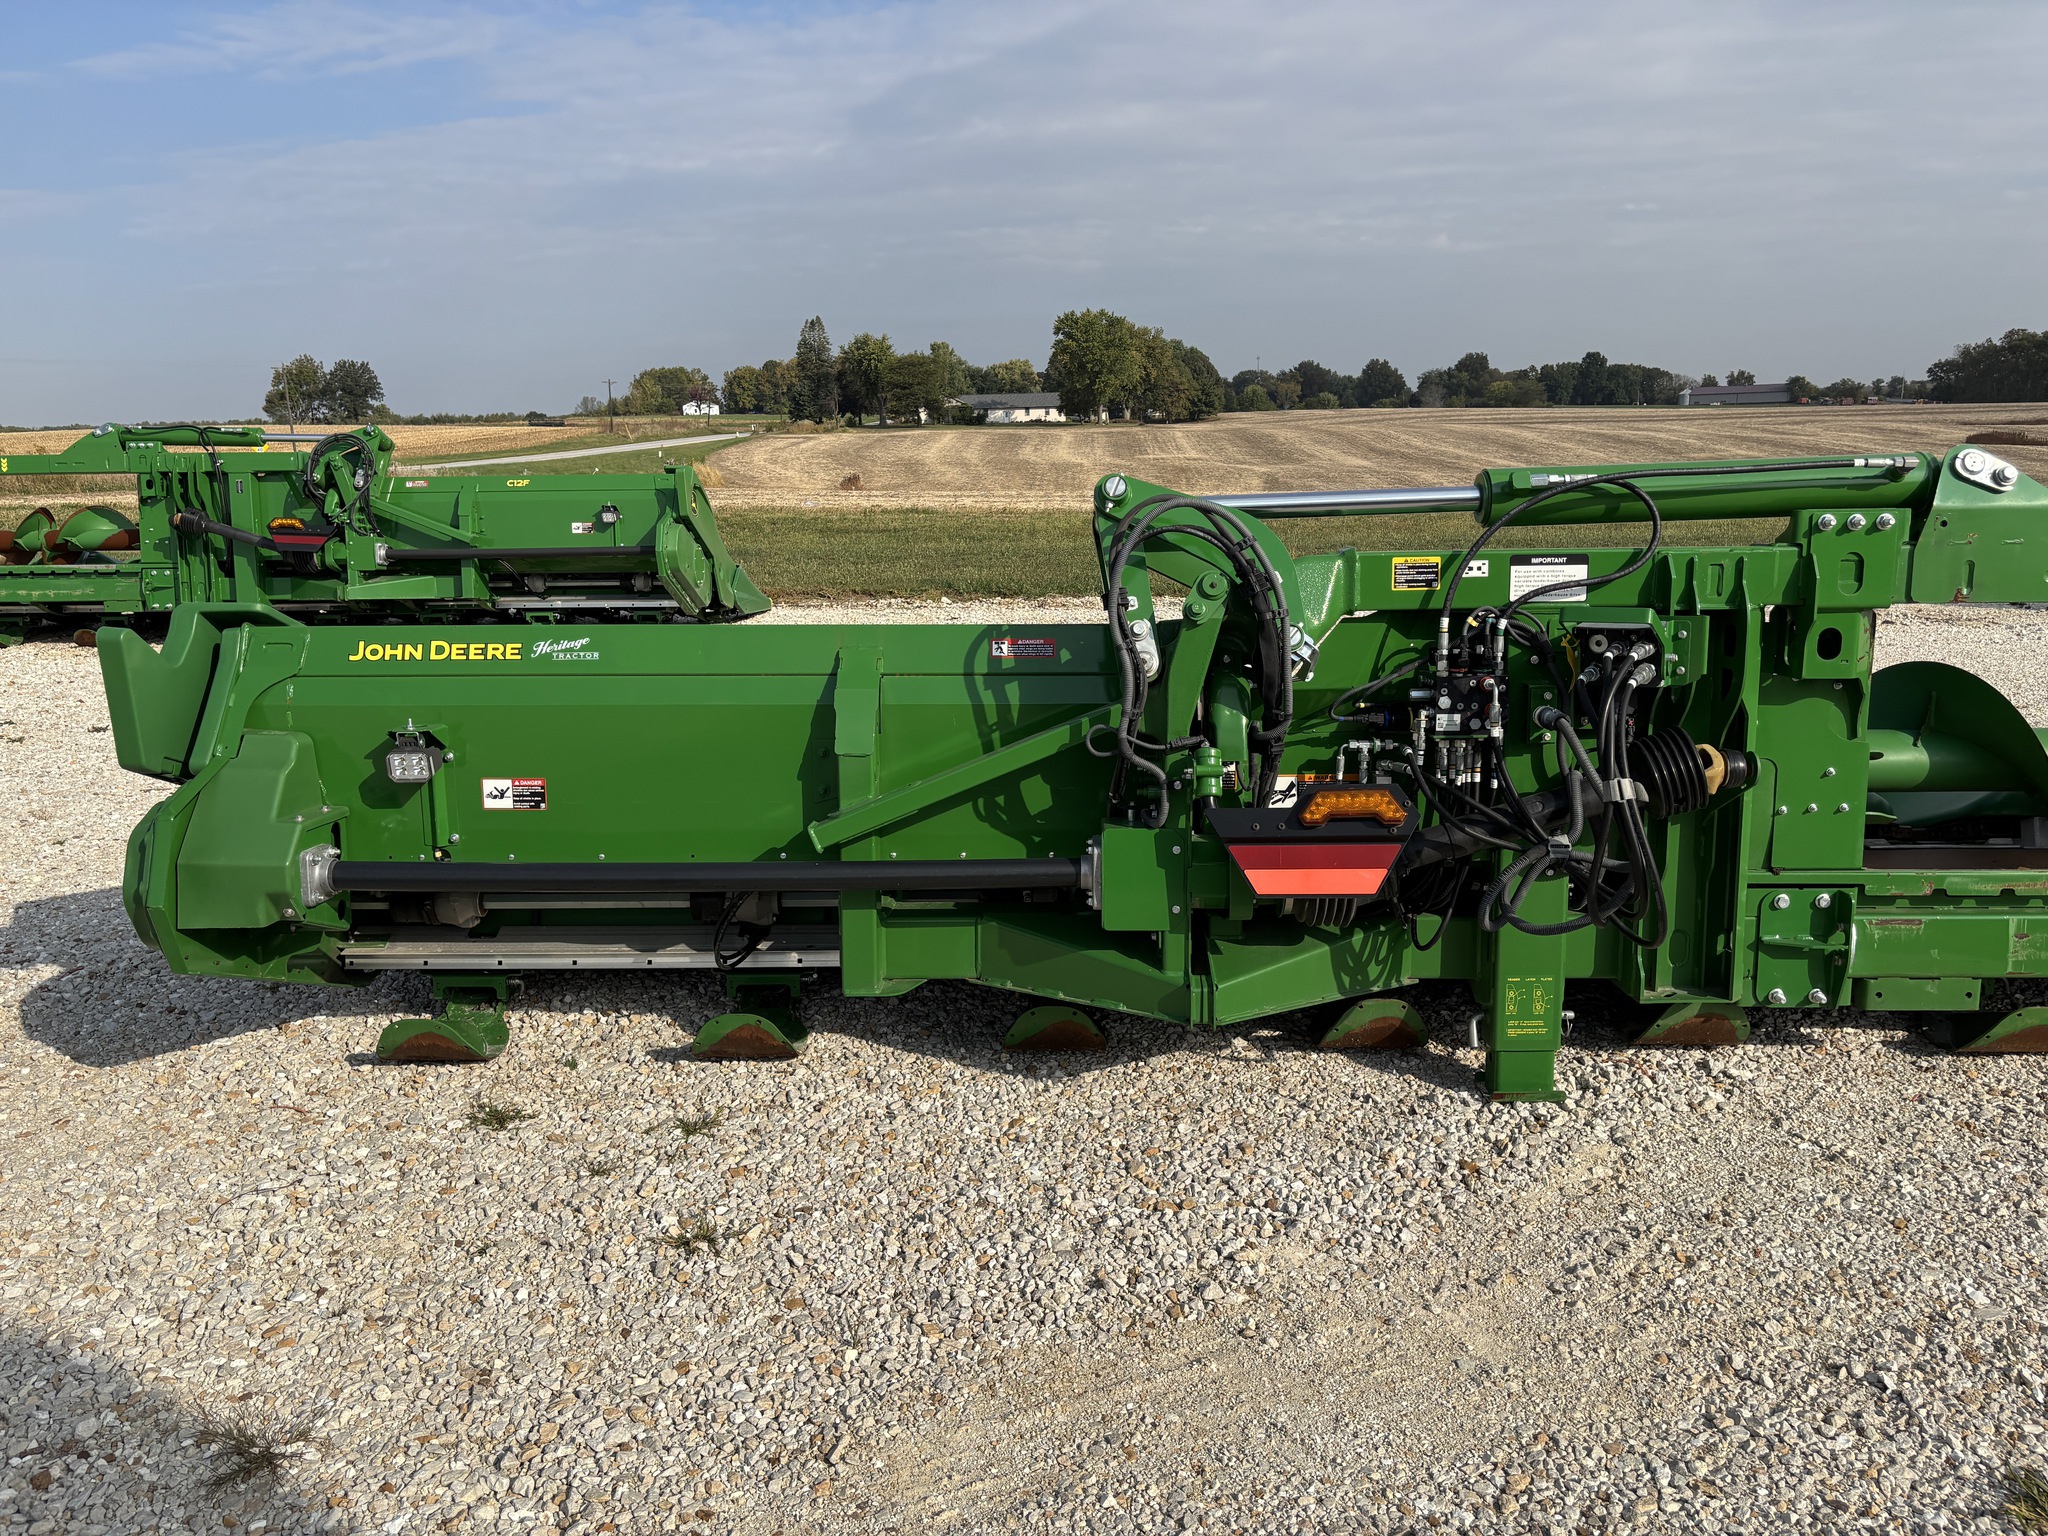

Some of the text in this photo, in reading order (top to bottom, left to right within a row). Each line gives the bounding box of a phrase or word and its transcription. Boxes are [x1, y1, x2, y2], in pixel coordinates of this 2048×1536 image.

[506, 479, 531, 487] C12F
[348, 640, 522, 661] JOHN DEERE
[530, 637, 591, 658] Heritage
[552, 651, 600, 661] TRACTOR
